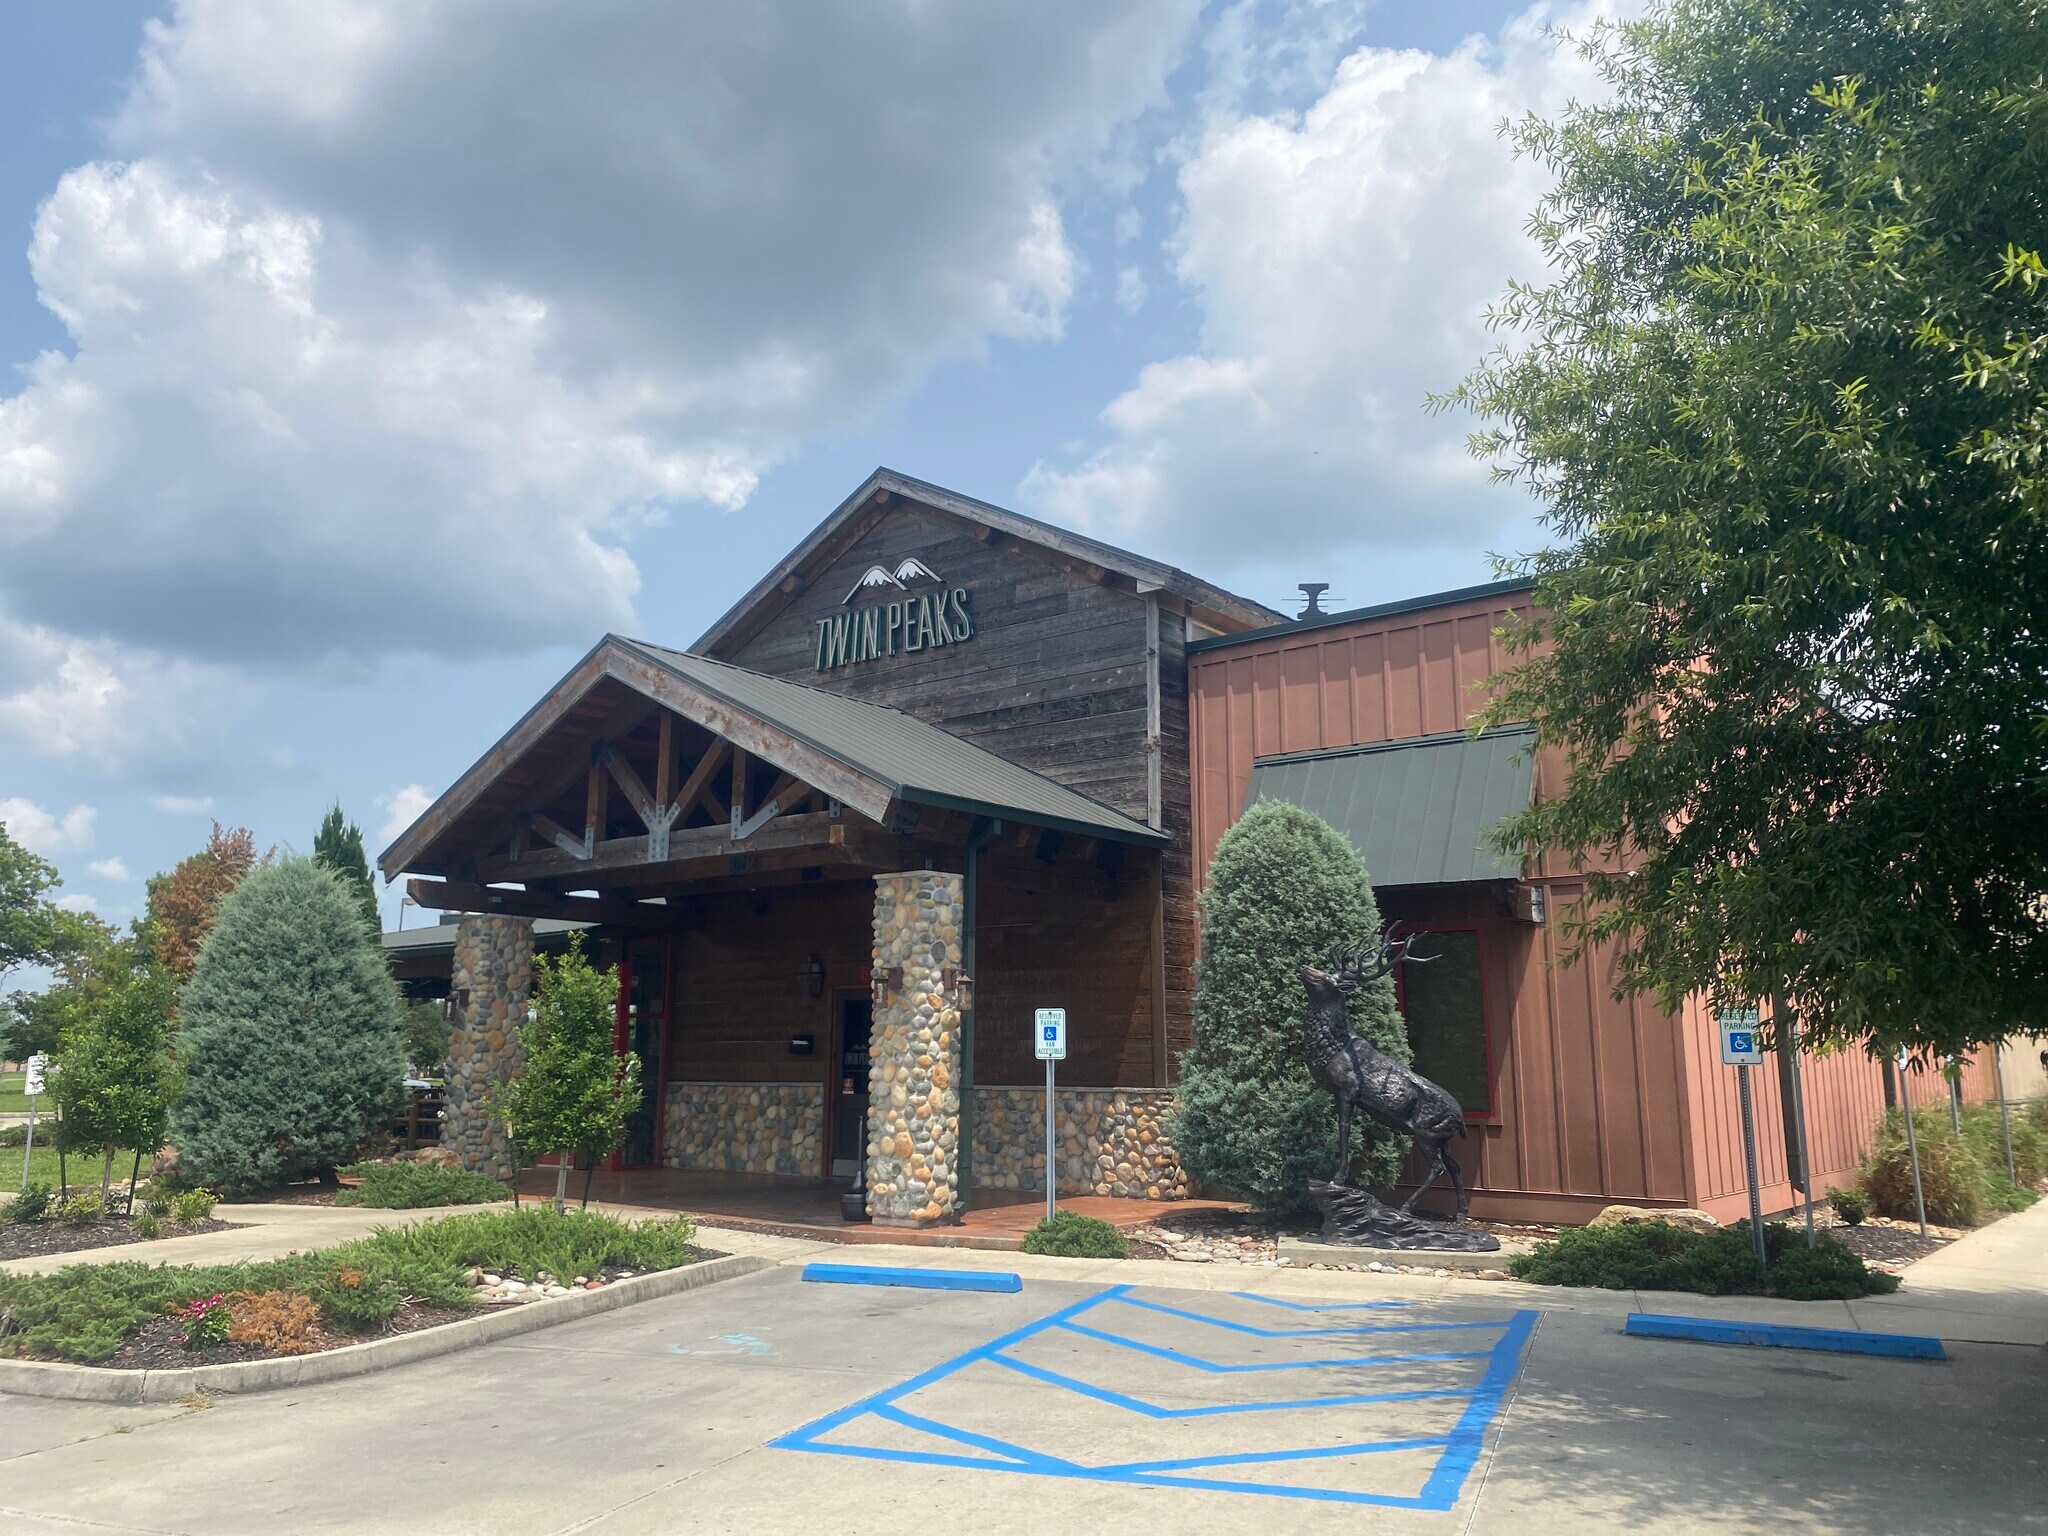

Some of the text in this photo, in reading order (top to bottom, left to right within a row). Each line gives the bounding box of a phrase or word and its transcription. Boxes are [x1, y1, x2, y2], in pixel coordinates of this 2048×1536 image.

[814, 587, 974, 671] TWIN PEAKS
[1038, 1047, 1063, 1055] ACCESSIBLE
